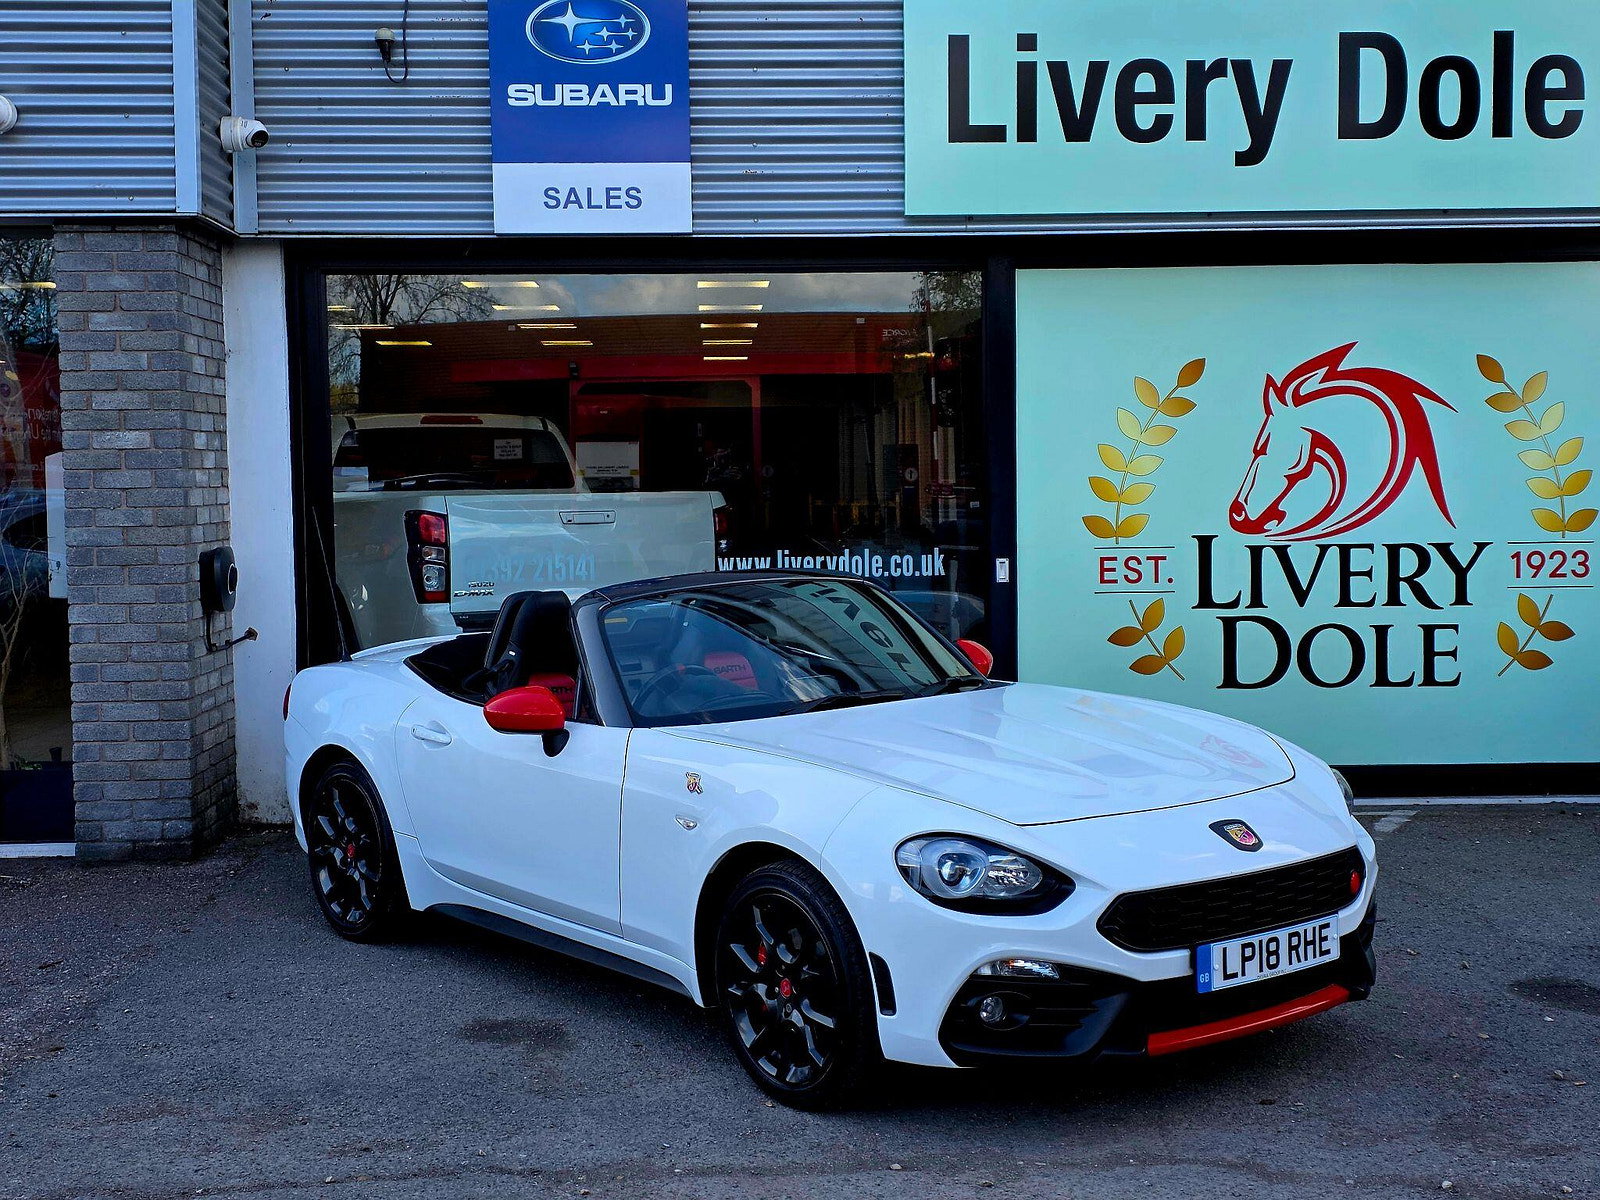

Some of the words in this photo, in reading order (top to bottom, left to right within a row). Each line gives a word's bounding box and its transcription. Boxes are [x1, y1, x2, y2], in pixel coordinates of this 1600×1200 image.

[507, 84, 673, 106] SUBARU
[948, 33, 1293, 167] Livery
[1338, 30, 1585, 140] Dole
[543, 187, 643, 209] SALES
[1100, 556, 1175, 584] EST.
[1191, 535, 1494, 609] LIVERY
[1511, 550, 1590, 579] 1923
[1216, 615, 1462, 689] DOLE
[713, 664, 746, 675] BARTH
[1222, 936, 1280, 981] LP18
[1288, 922, 1331, 966] RHE
[1199, 972, 1210, 984] GB
